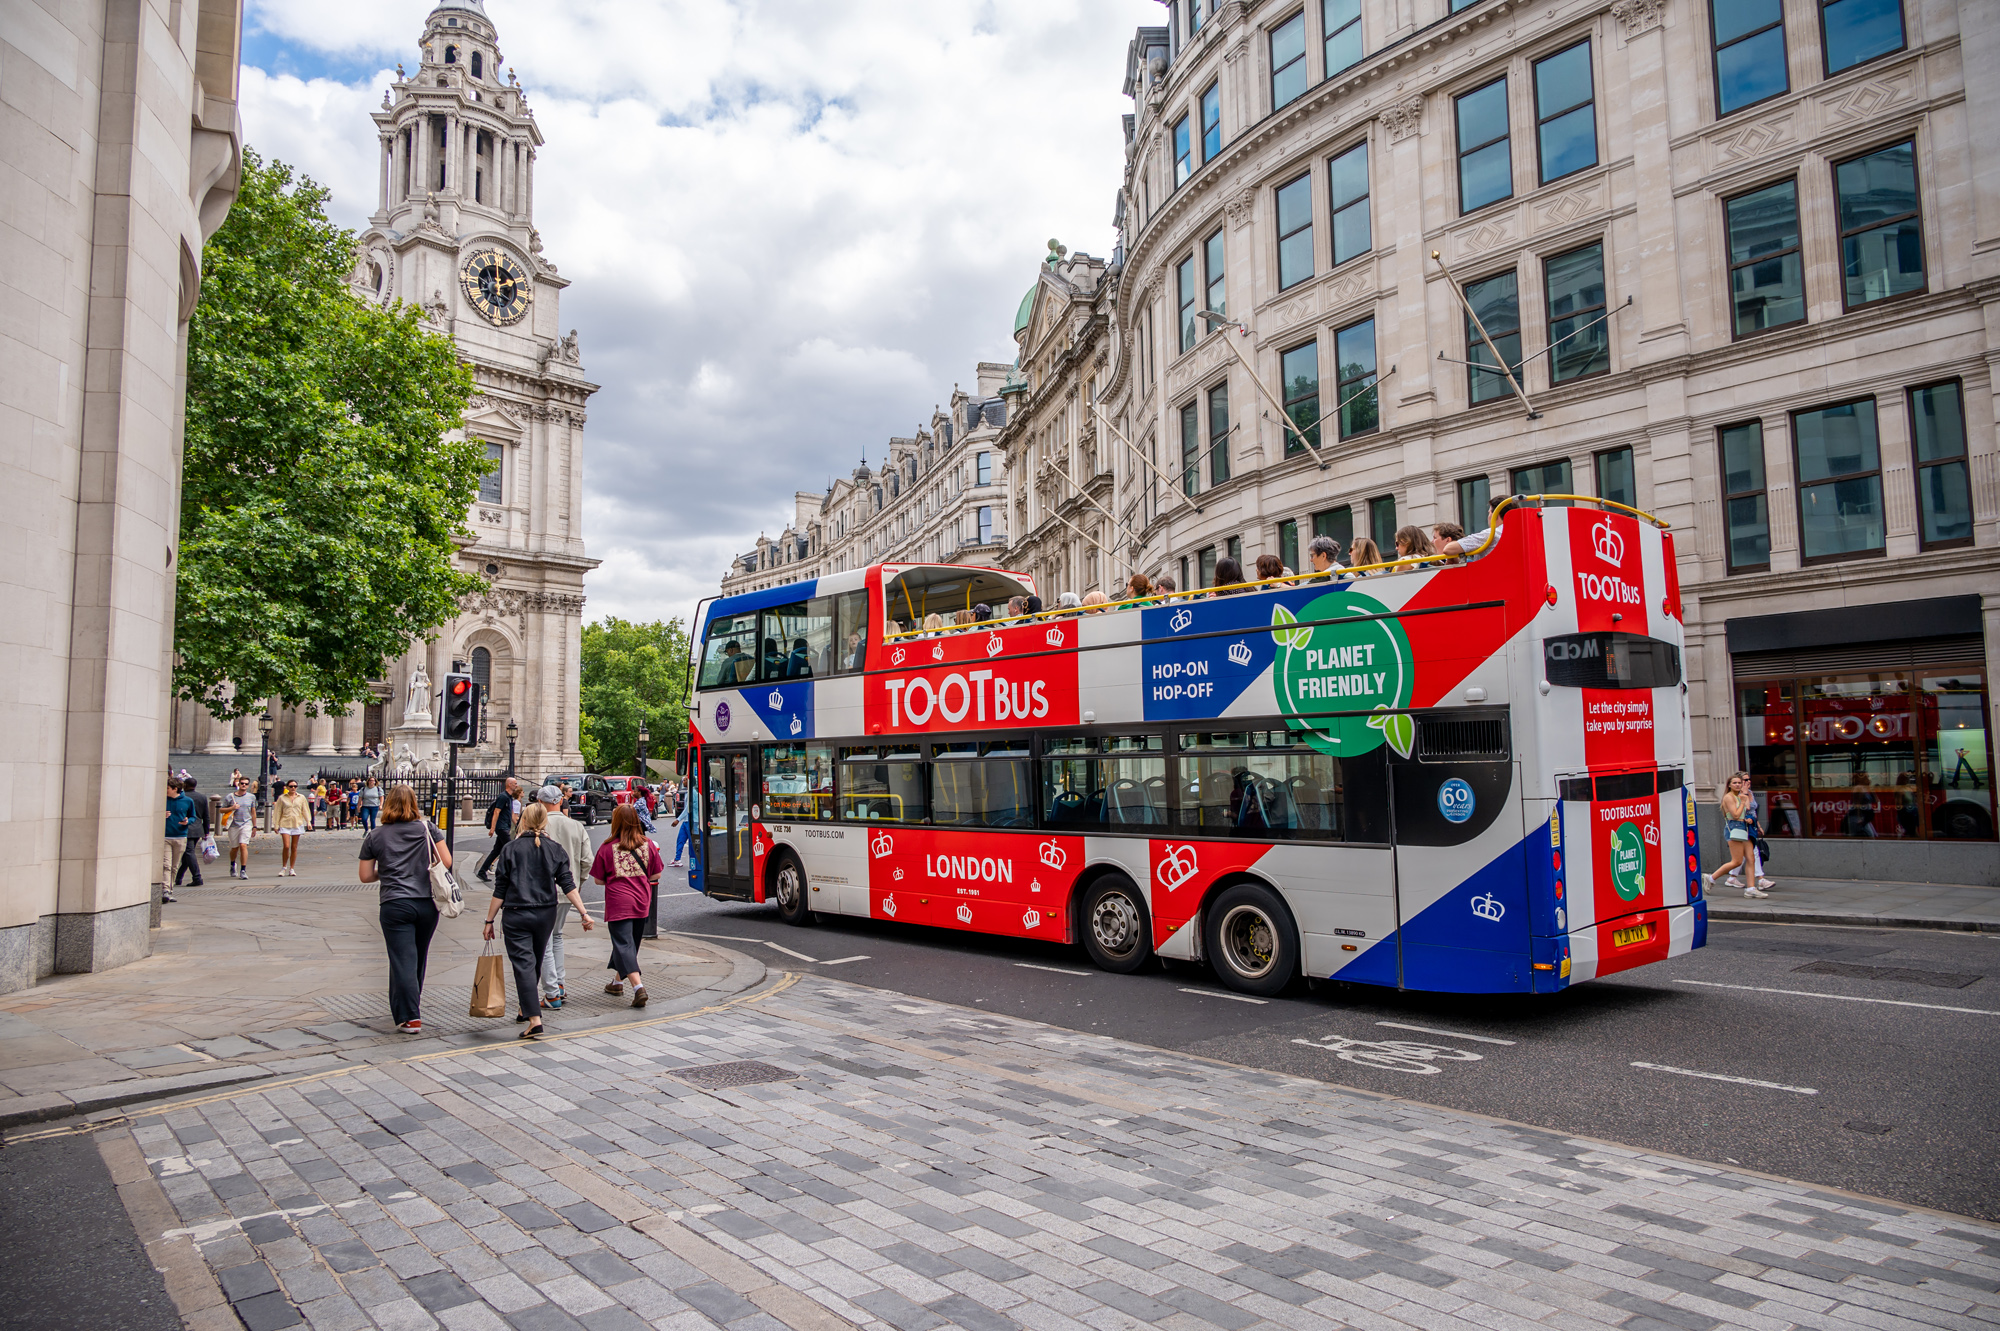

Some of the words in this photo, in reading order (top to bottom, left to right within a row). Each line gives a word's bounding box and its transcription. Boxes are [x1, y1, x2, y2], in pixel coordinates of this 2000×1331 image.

[1306, 644, 1375, 671] PLANET
[1152, 660, 1208, 679] HOP-ON
[1153, 682, 1213, 701] HOP-OFF
[1298, 672, 1386, 699] FRIENDLY
[1589, 702, 1600, 714] Let
[1601, 701, 1612, 714] the
[1613, 701, 1626, 716] city
[1627, 701, 1648, 716] simply
[1586, 719, 1602, 732] take
[1603, 721, 1615, 734] you
[1616, 718, 1625, 733] by
[1626, 717, 1652, 733] surprise
[1442, 787, 1468, 806] 60
[1600, 803, 1651, 821] TOOTBUS.COM
[773, 825, 782, 833] VXE
[805, 830, 844, 839] TOOTBUS.COM
[1620, 848, 1637, 860] PLANET
[926, 854, 1012, 883] LONDON
[1618, 860, 1639, 873] FRIENDLY
[1618, 929, 1632, 944] YJ11
[1631, 926, 1645, 940] TVX
